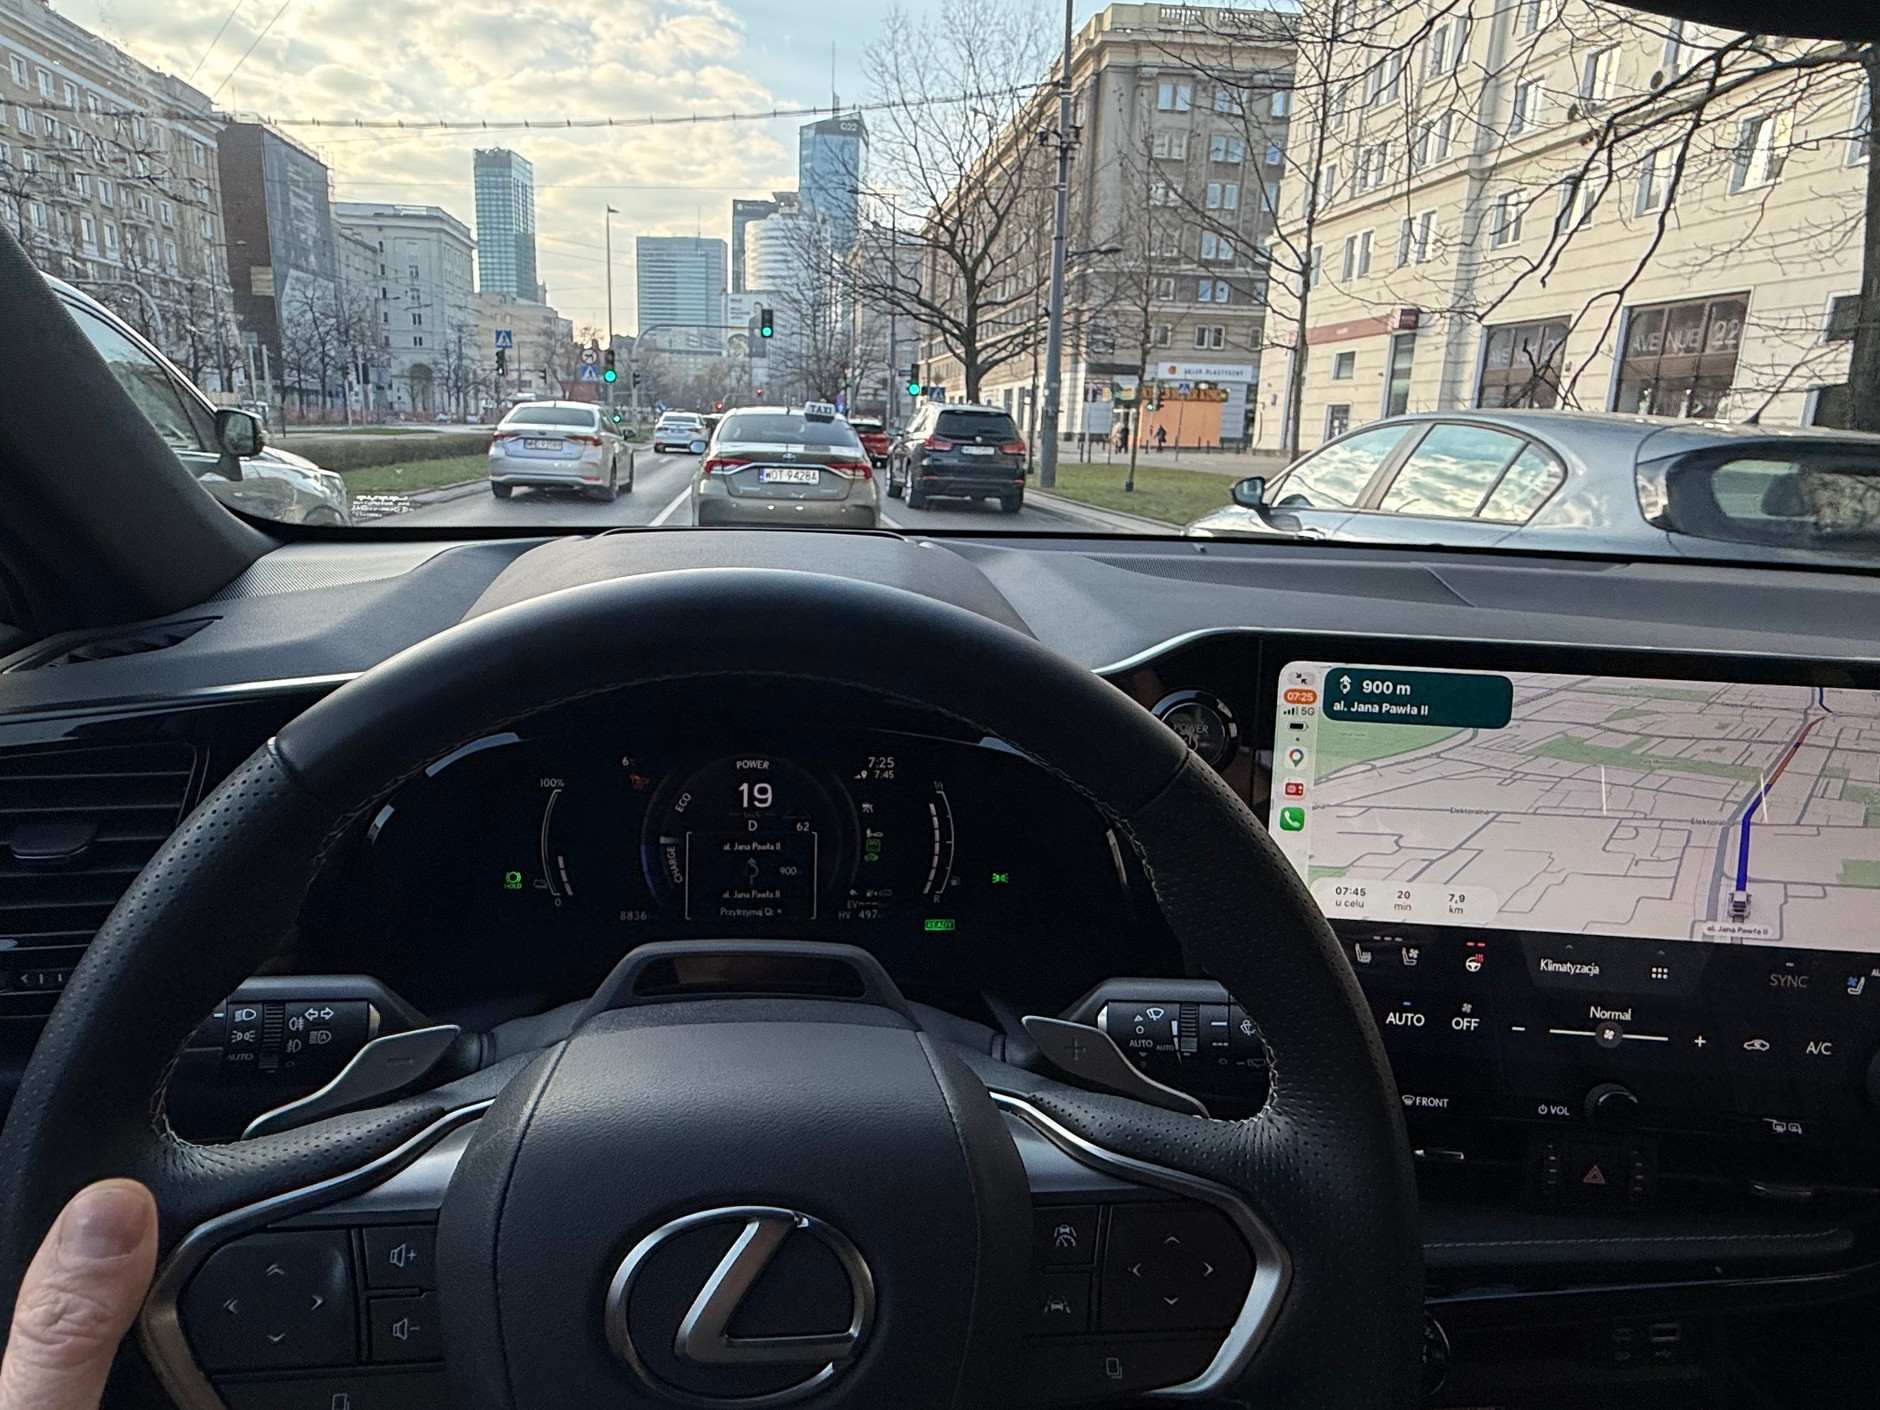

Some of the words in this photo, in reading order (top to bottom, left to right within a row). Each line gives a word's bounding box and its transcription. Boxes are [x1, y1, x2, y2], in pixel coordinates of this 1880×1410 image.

[1711, 319, 1740, 345] 22
[809, 404, 833, 415] TAXI
[1362, 679, 1393, 695] 900
[1396, 683, 1411, 696] m
[1286, 691, 1314, 702] 07:25
[1301, 707, 1315, 716] 5G
[1333, 699, 1348, 712] al.
[1350, 701, 1379, 714] Jana
[1382, 703, 1418, 716] Pawła
[735, 759, 770, 770] POWER
[867, 756, 895, 769] 7:25
[874, 769, 895, 780] 7:45
[539, 778, 566, 789] 100%
[738, 782, 773, 809] 19
[674, 792, 692, 814] ECO
[747, 820, 758, 832] D
[796, 821, 810, 832] 62
[666, 845, 684, 884] CHARGE
[779, 866, 797, 876] 900
[1335, 887, 1367, 898] 07:45
[1397, 890, 1411, 900] 20
[1344, 899, 1365, 909] celu
[1448, 894, 1466, 904] 7,9
[1394, 902, 1412, 912] min
[1448, 905, 1464, 915] km
[858, 908, 878, 920] 497
[1539, 958, 1601, 977] Klimatyzacja
[1769, 973, 1809, 988] SYNC
[1589, 1005, 1632, 1021] Normal
[1385, 1012, 1425, 1027] AUTO
[1451, 1017, 1480, 1031] OFF
[1129, 1039, 1154, 1049] AUTO
[1805, 1040, 1832, 1055] A/C
[1415, 1095, 1450, 1109] FRONT
[1549, 1105, 1571, 1116] VOL
